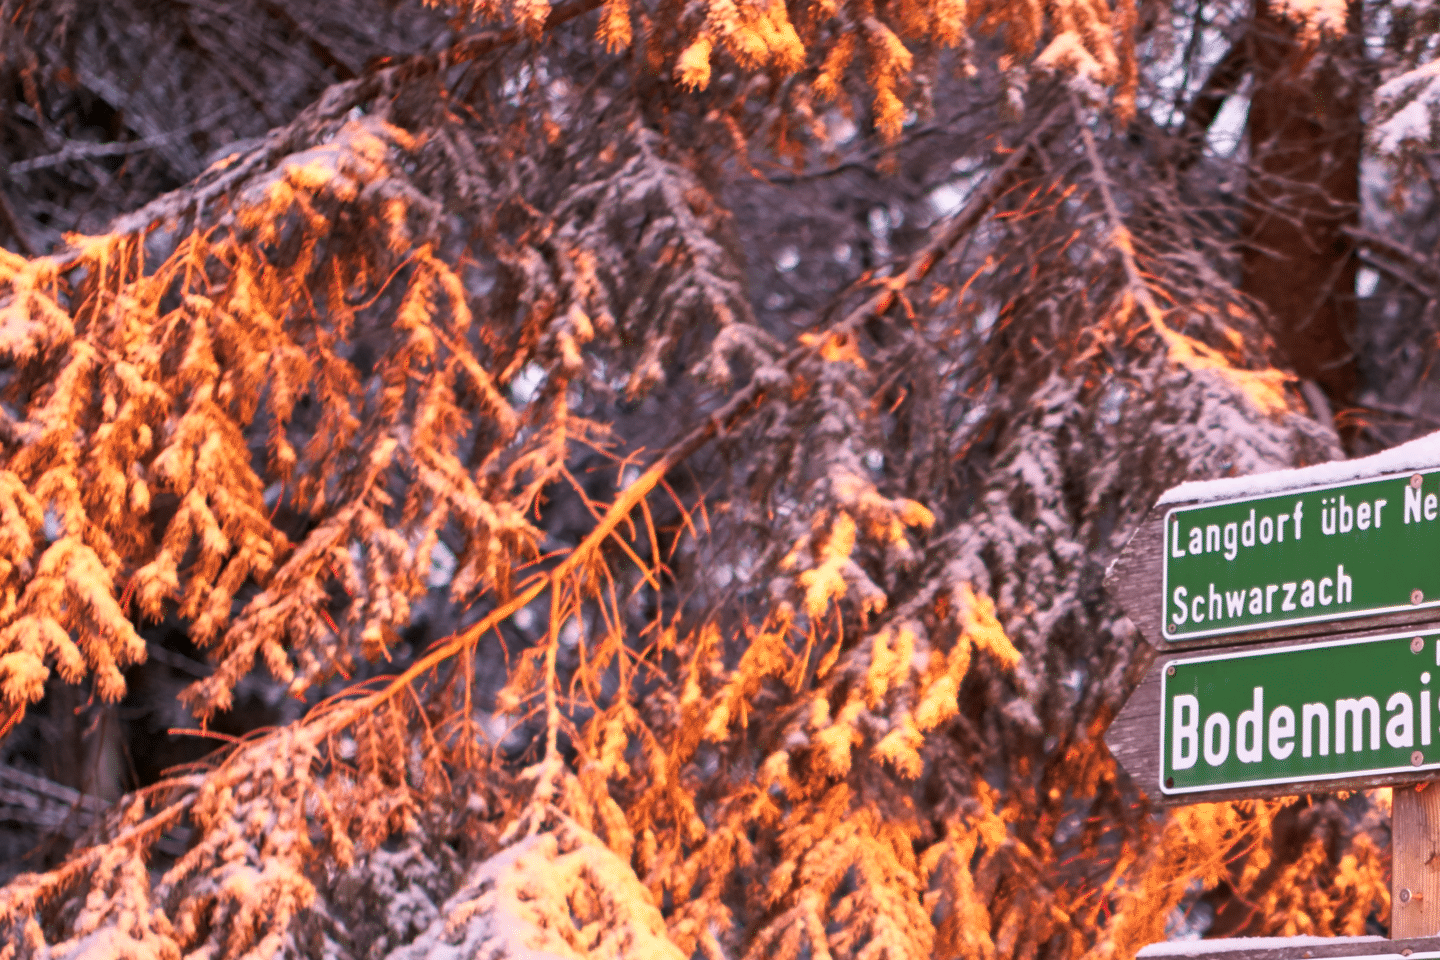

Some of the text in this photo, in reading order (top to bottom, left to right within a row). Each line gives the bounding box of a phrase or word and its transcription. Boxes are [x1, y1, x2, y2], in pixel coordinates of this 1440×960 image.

[1171, 502, 1303, 561] Langdorf
[1321, 495, 1387, 536] über
[1172, 564, 1353, 626] Schwarzach
